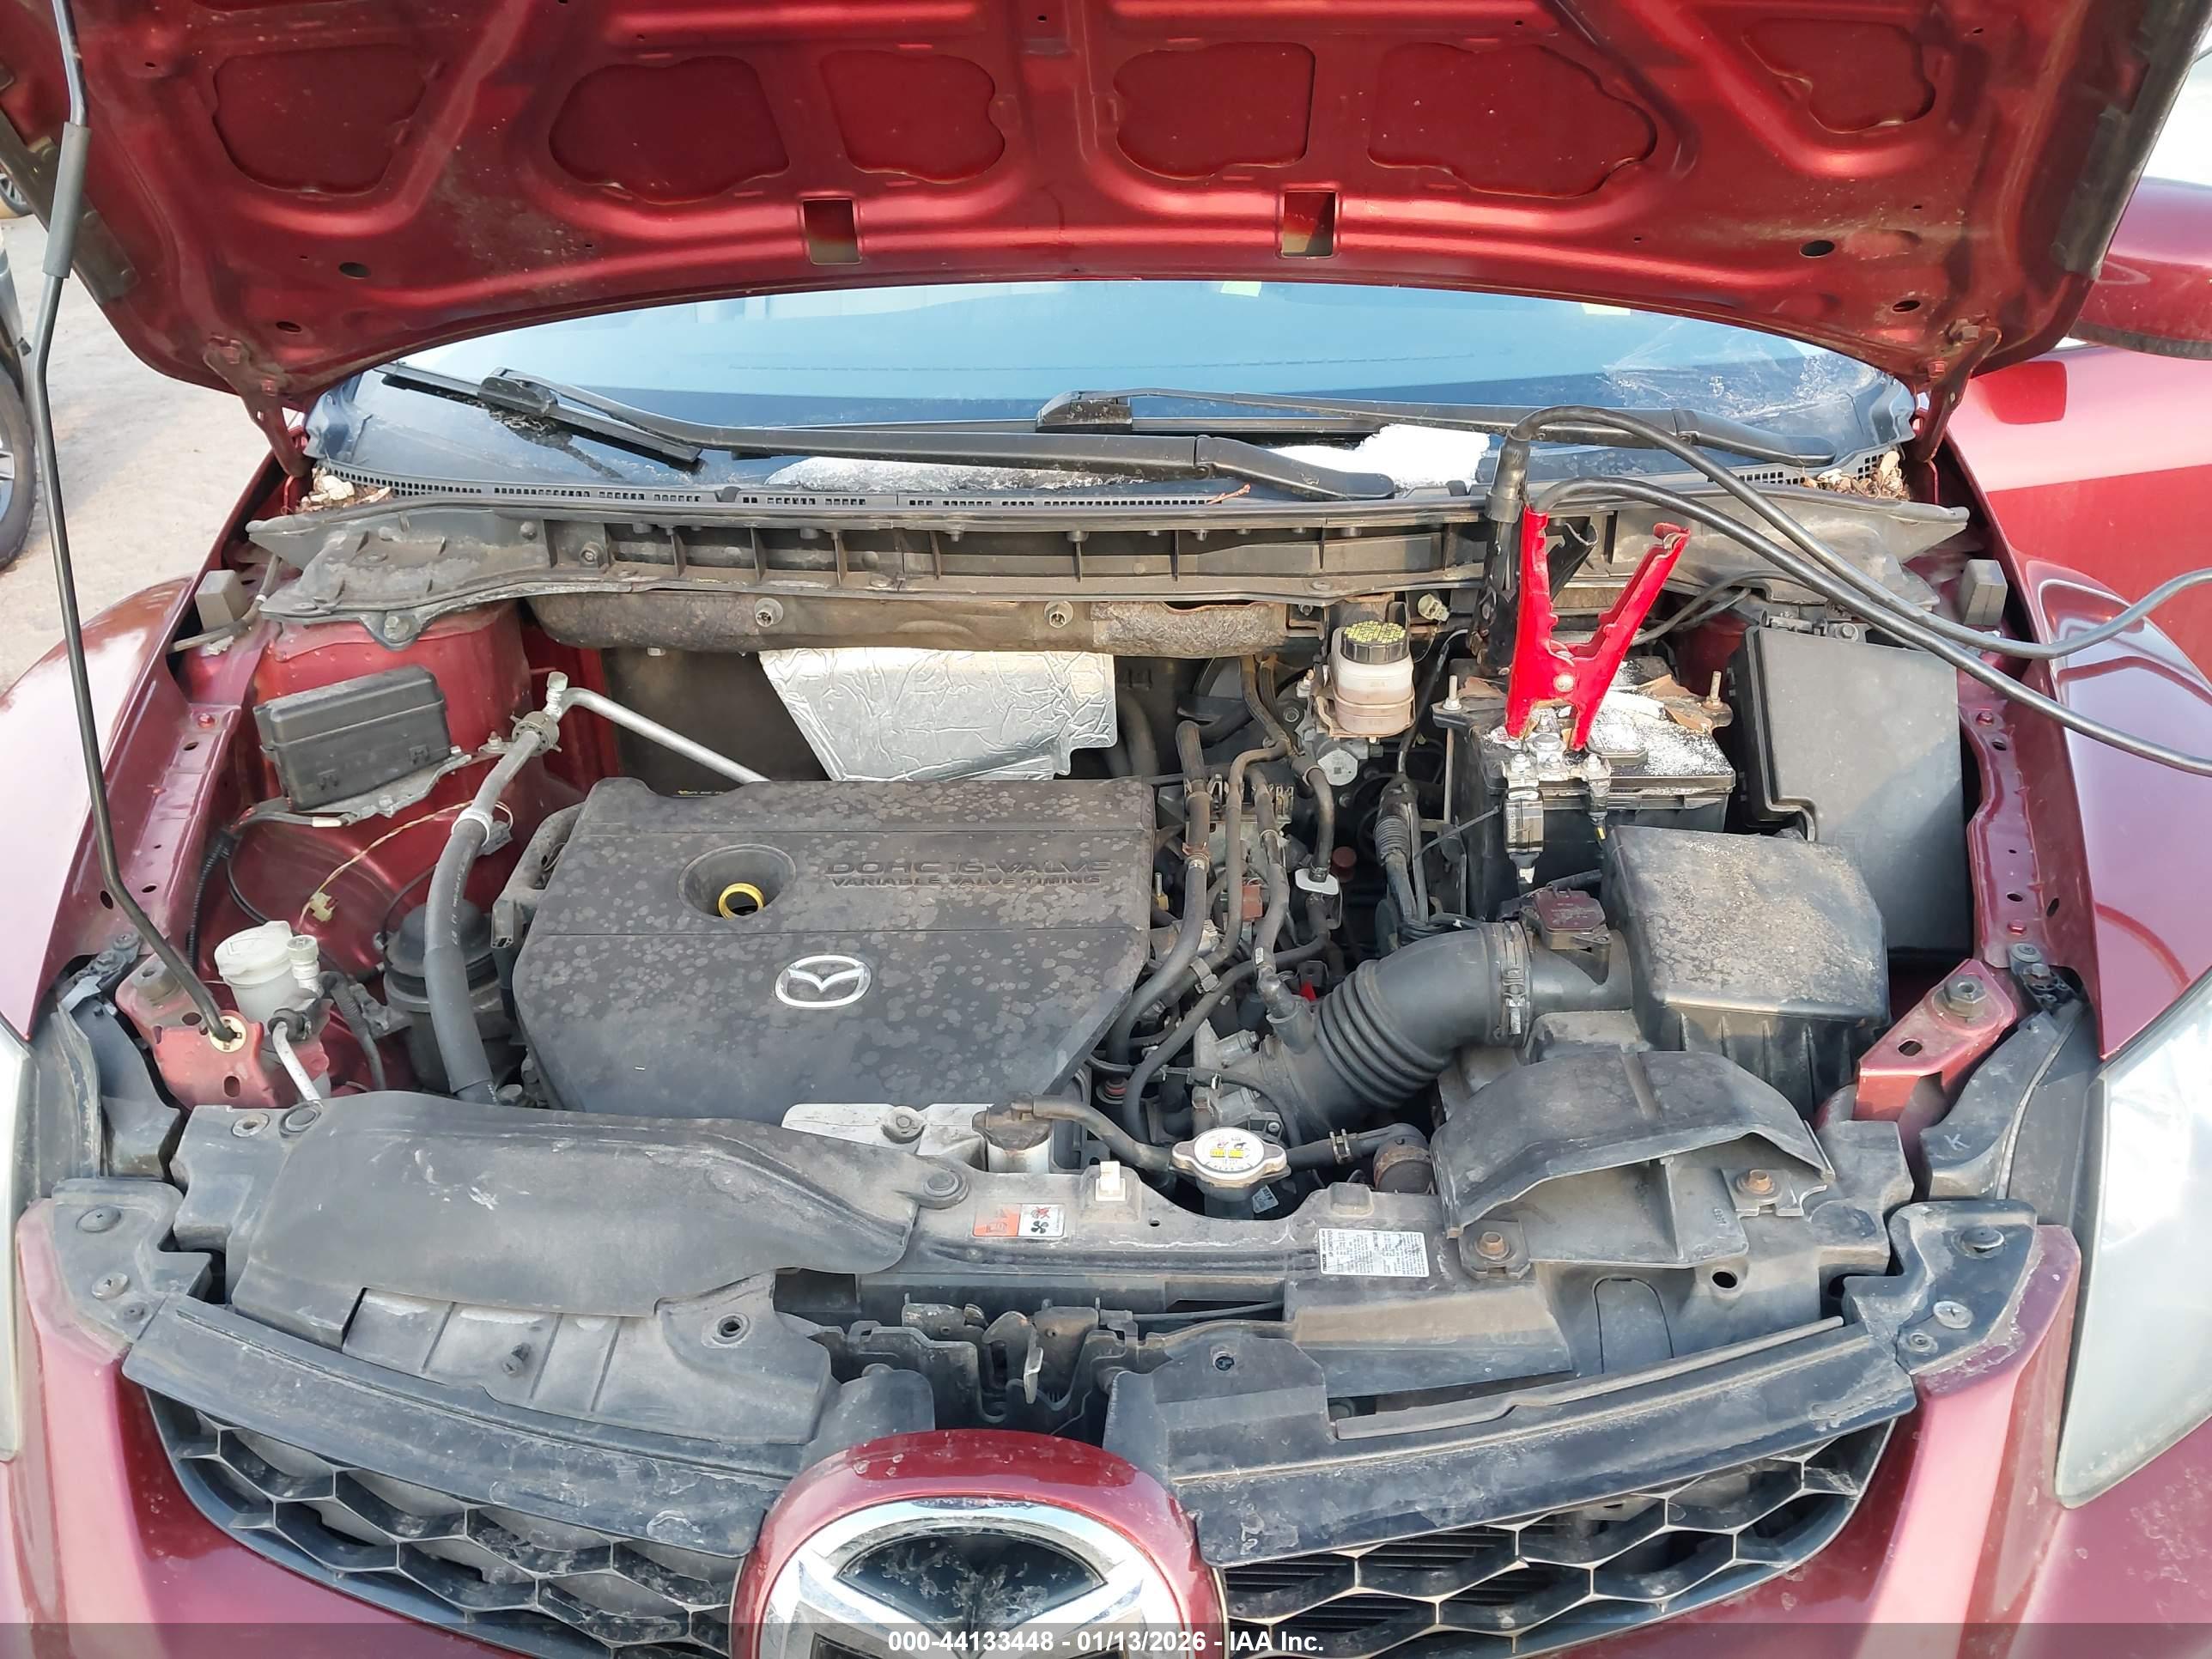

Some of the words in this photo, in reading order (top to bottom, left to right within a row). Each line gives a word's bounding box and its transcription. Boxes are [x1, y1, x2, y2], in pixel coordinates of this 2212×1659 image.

[825, 861, 942, 877] DOHC
[948, 860, 1111, 876] 16-VALVE
[830, 878, 941, 888] VARIABLE
[949, 878, 1016, 888] VALVE
[1023, 877, 1100, 887] TIMING
